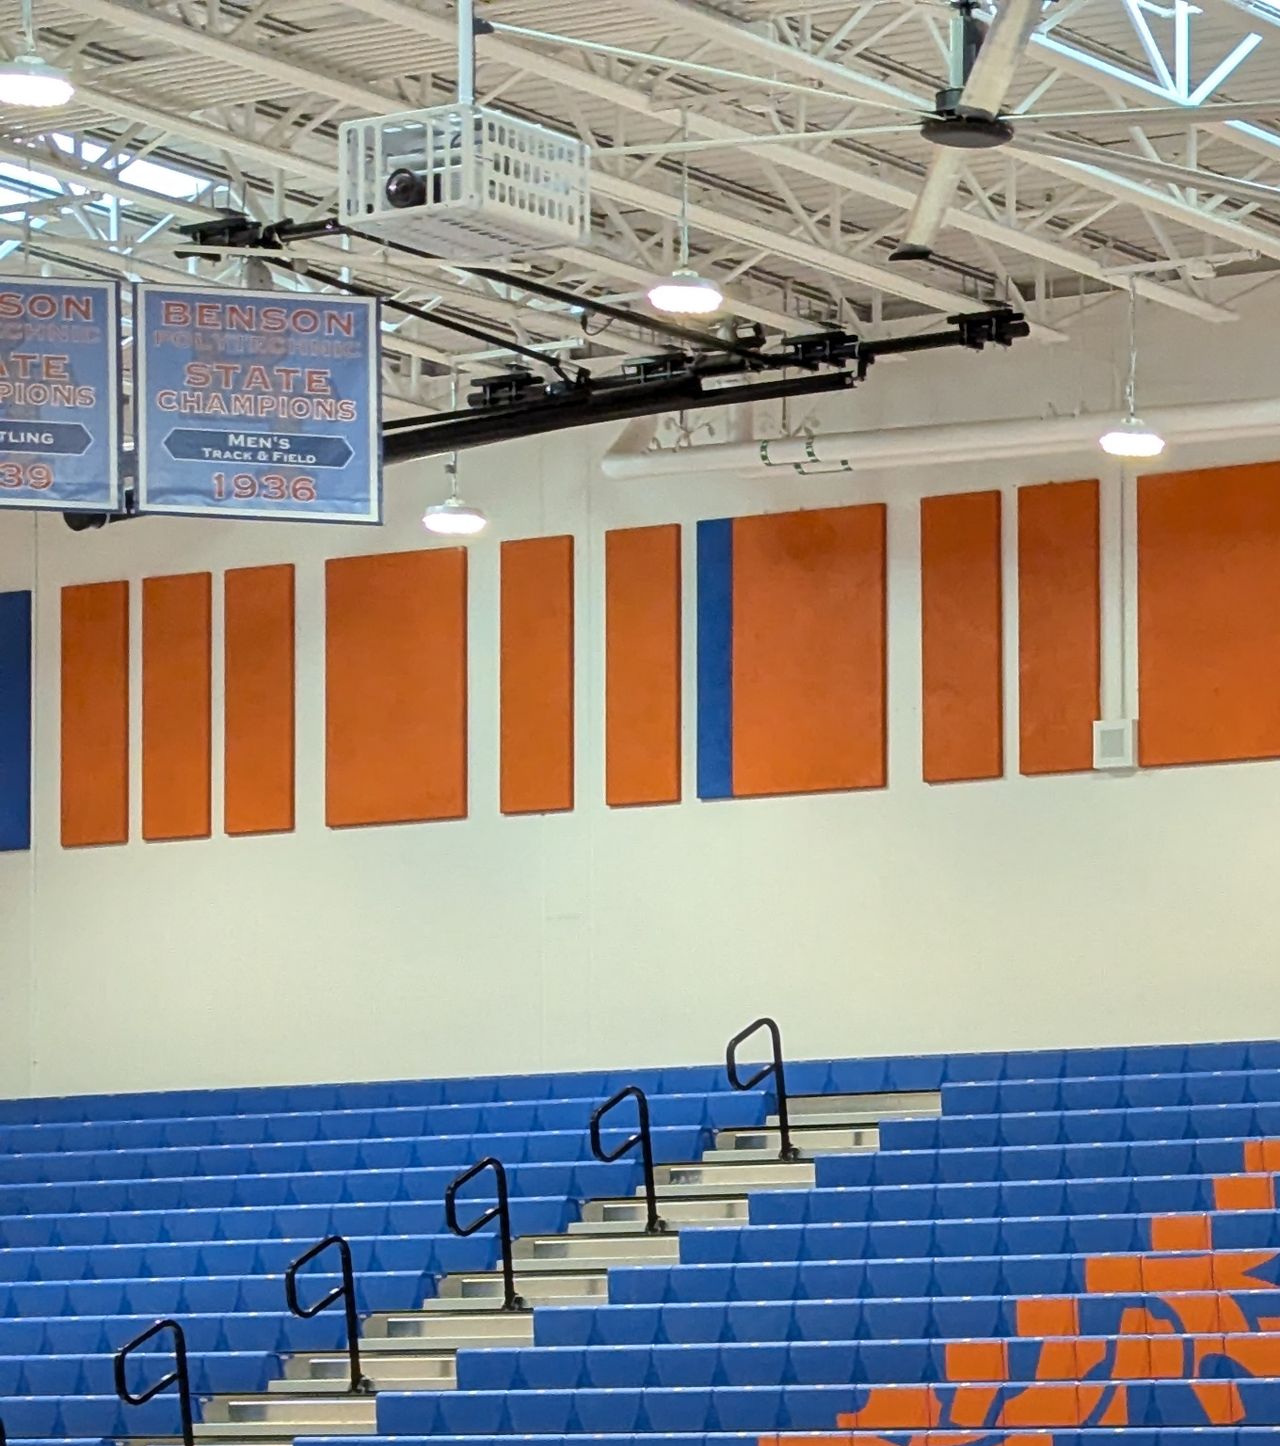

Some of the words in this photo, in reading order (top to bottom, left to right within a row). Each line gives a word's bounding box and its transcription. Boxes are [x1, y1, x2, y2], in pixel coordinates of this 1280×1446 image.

[161, 300, 355, 337] BENSON
[184, 361, 332, 395] STATE
[156, 389, 358, 422] CHAMPIONS
[256, 450, 270, 462] &
[212, 471, 317, 503] 1936
